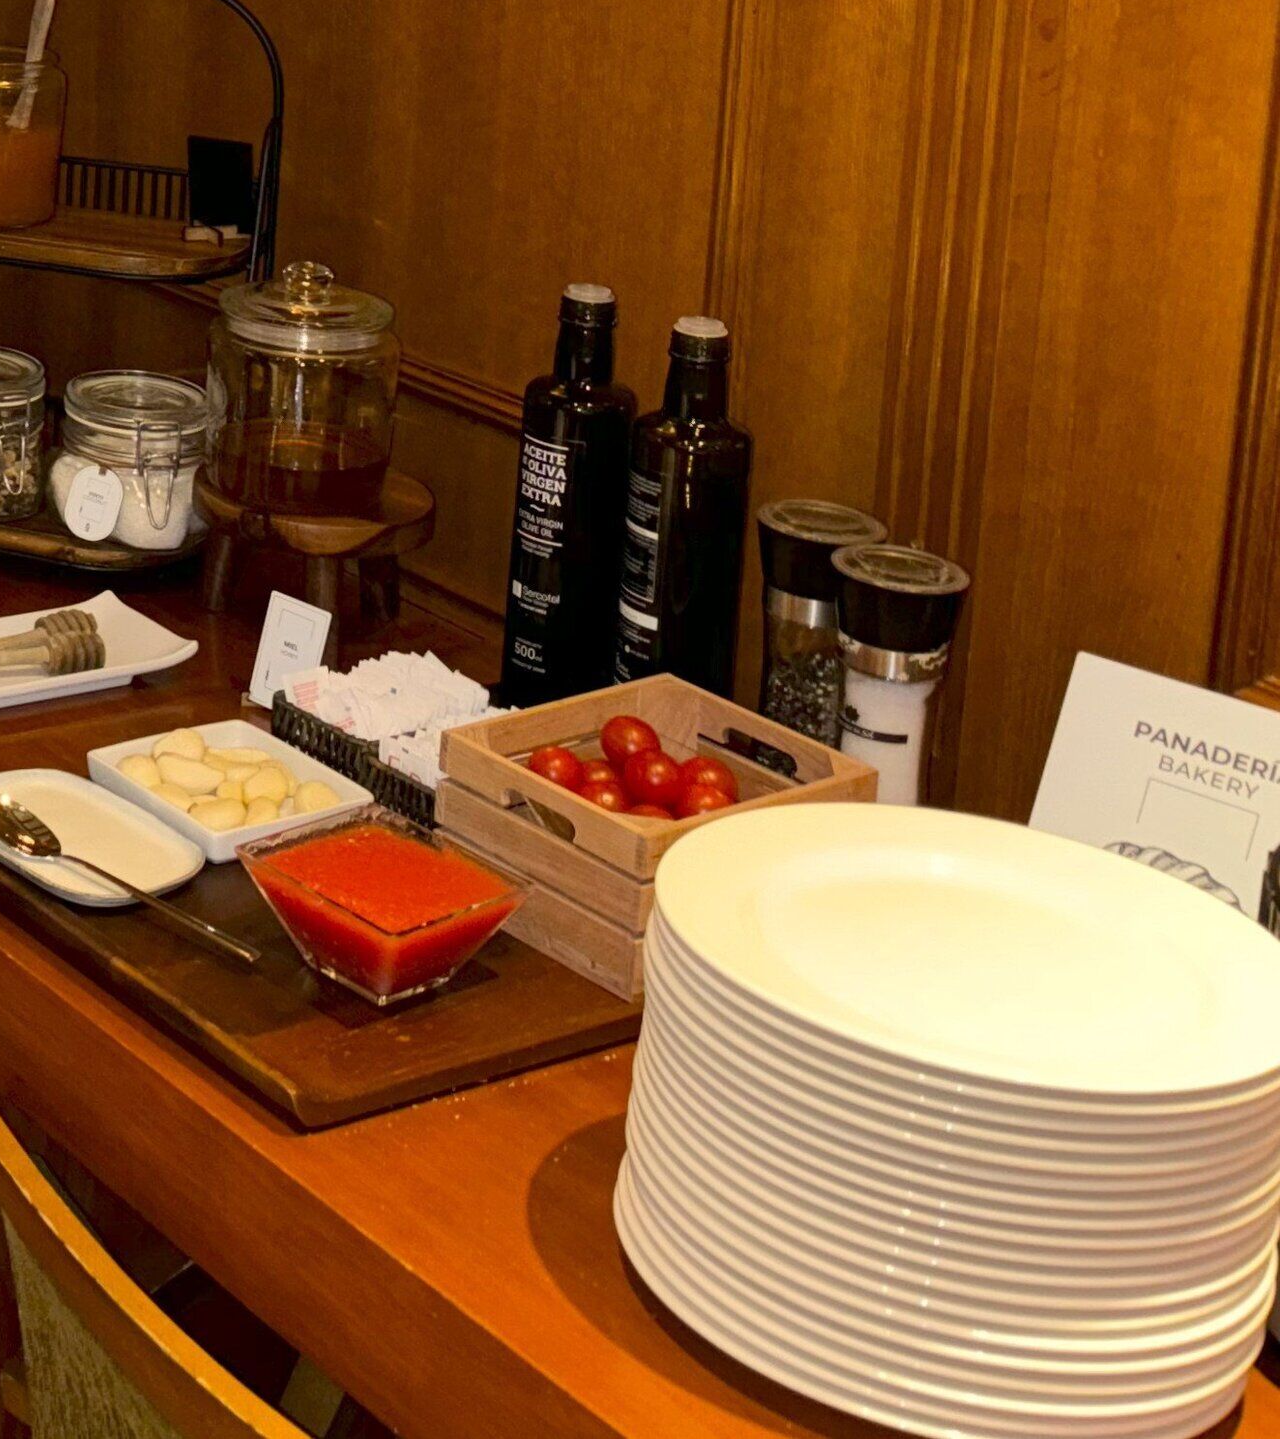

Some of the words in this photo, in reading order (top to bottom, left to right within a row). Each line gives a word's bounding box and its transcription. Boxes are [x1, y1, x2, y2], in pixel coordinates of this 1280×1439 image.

[523, 442, 567, 466] ACEITE
[521, 468, 566, 494] VIRGEN
[528, 459, 567, 480] OLIVA
[521, 482, 562, 507] EXTRA
[1134, 721, 1280, 785] PANADERÍ
[1158, 754, 1260, 800] BAKERY
